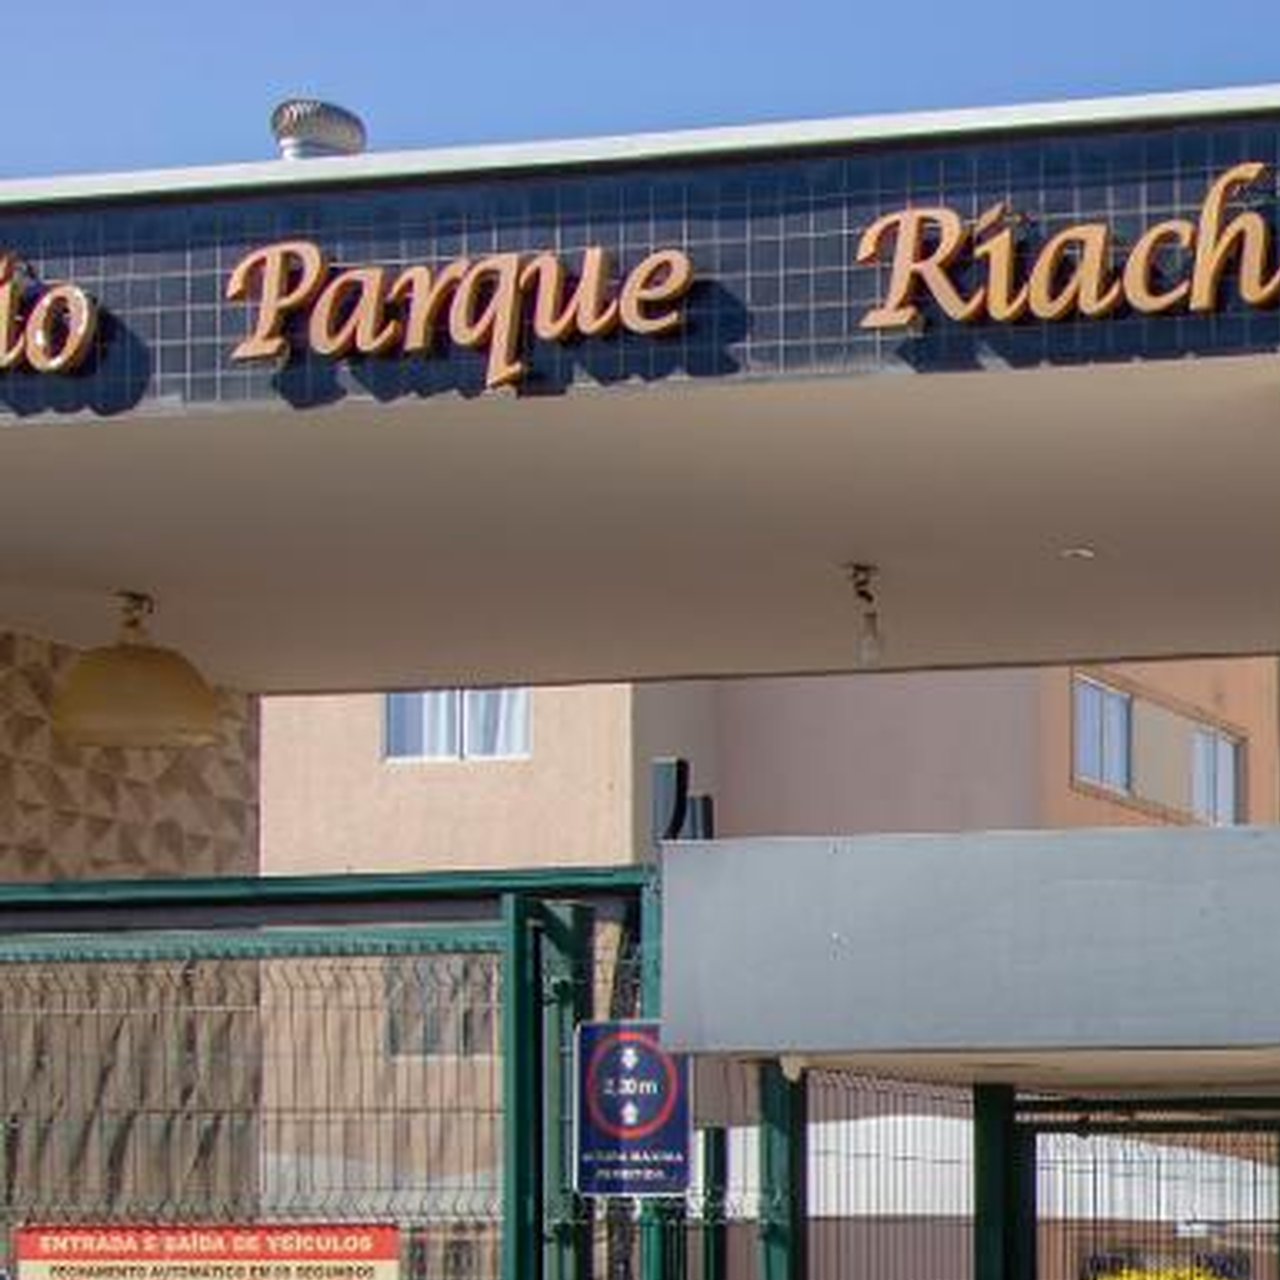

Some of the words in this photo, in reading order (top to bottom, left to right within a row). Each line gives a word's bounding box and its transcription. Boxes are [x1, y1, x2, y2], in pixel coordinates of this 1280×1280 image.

[226, 240, 694, 393] Parque
[39, 1234, 138, 1252] ENTRADA
[162, 1230, 225, 1252] SAÍDA
[231, 1234, 260, 1252] DE
[266, 1231, 374, 1253] VEÍCULOS
